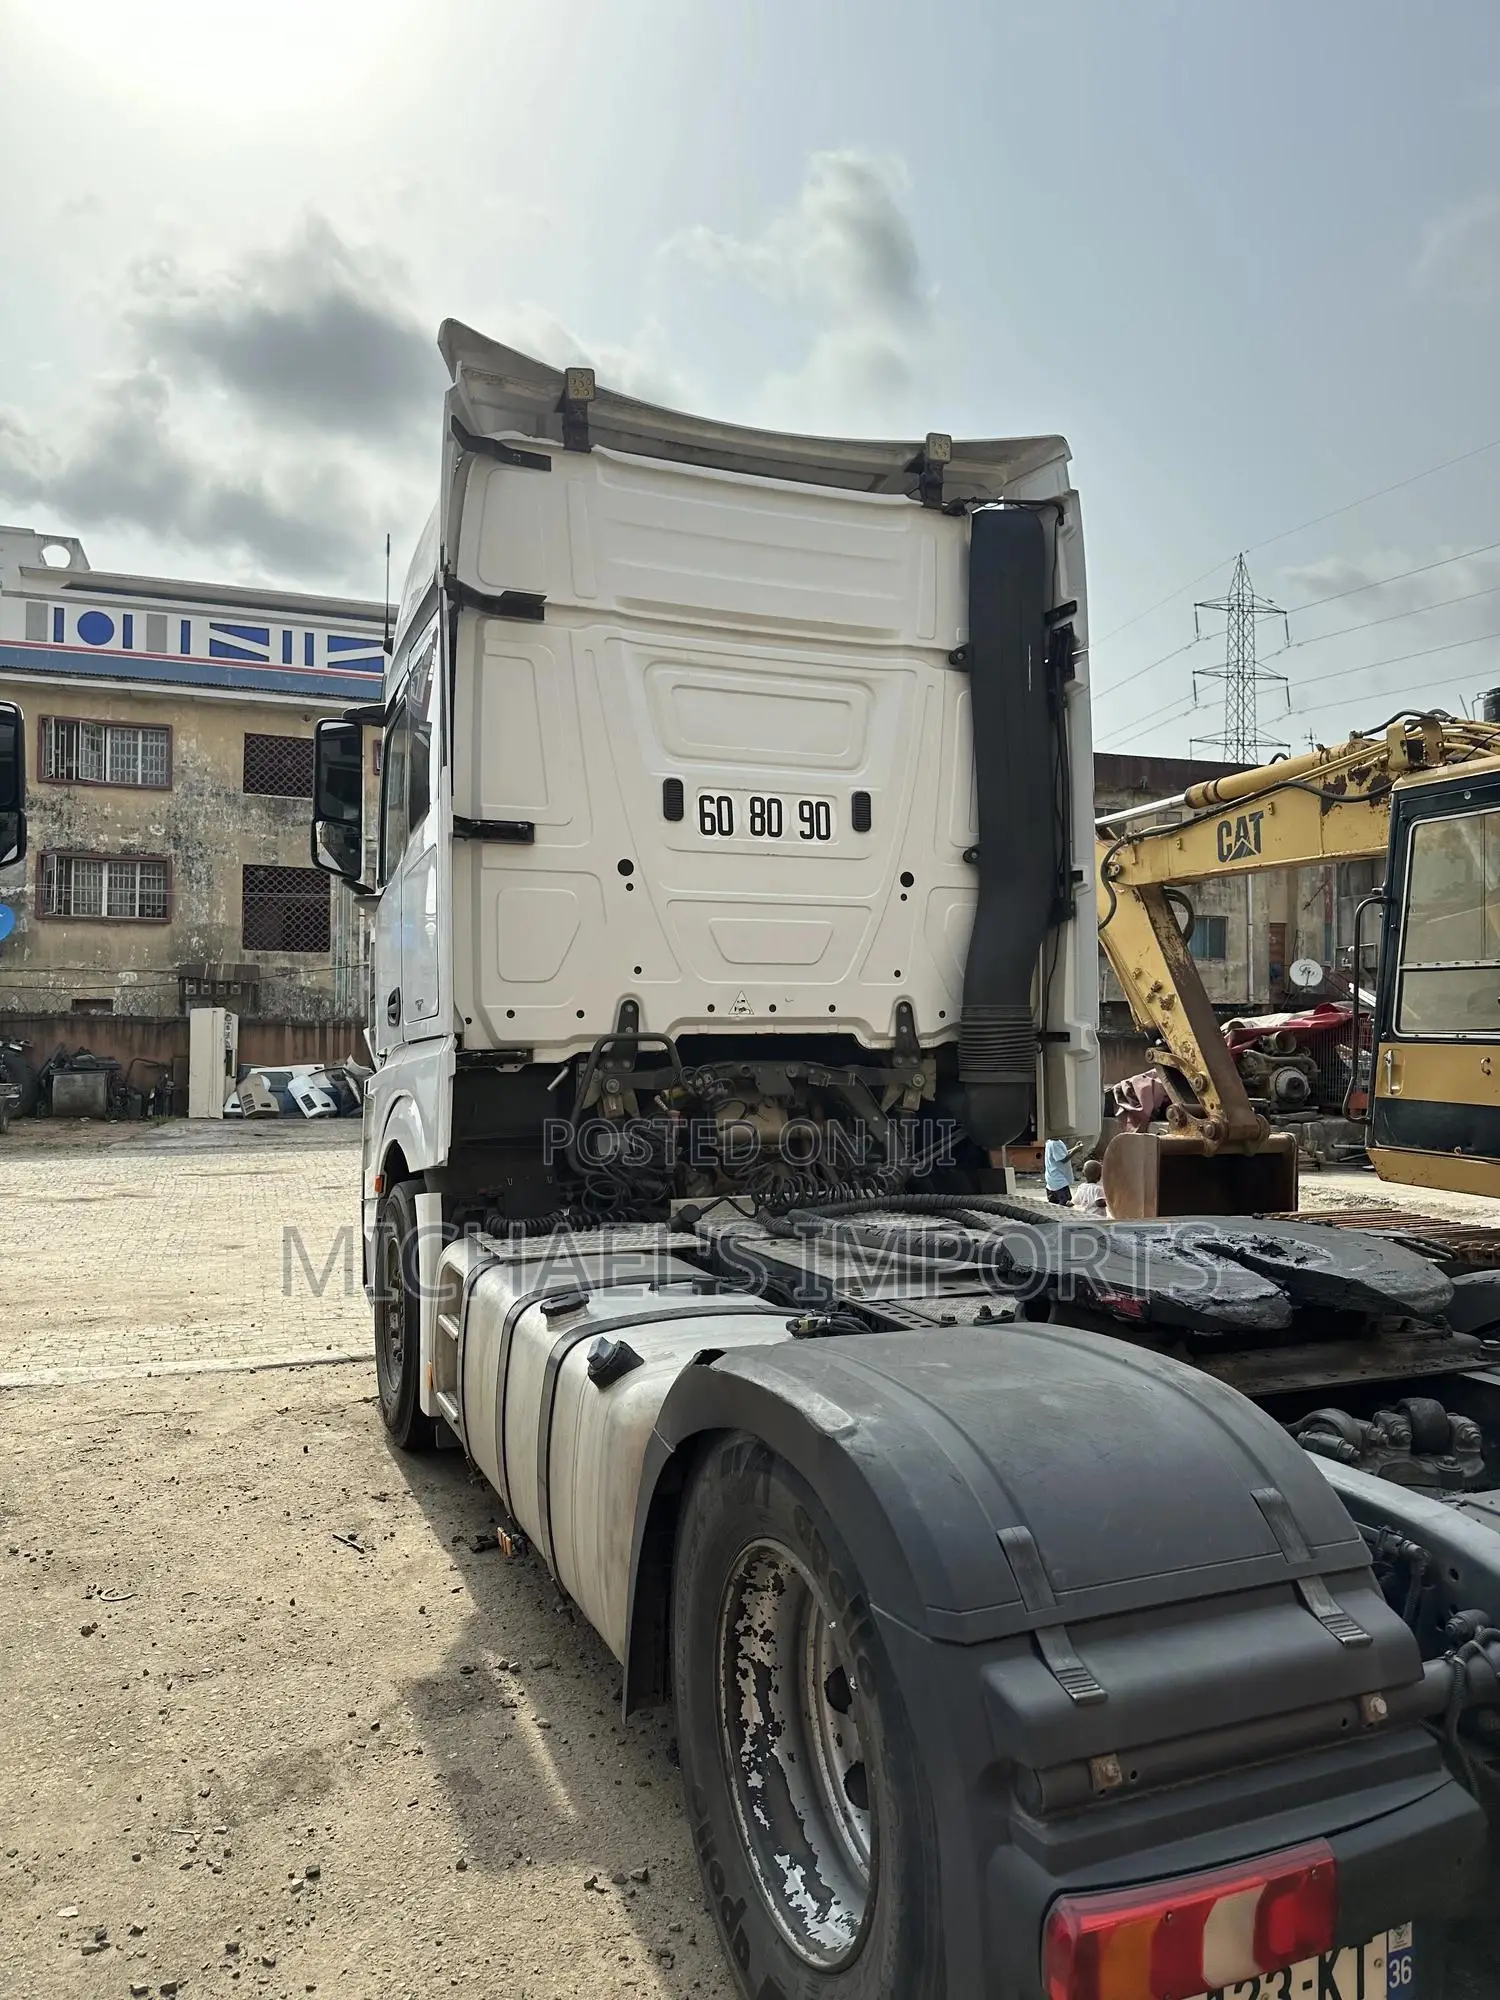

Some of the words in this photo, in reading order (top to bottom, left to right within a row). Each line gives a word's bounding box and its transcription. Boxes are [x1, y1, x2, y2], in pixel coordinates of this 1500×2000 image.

[698, 795, 734, 836] 60
[750, 796, 783, 838] 80
[799, 800, 831, 841] 90
[1217, 810, 1264, 863] CAT
[1388, 1955, 1413, 1989] 36
